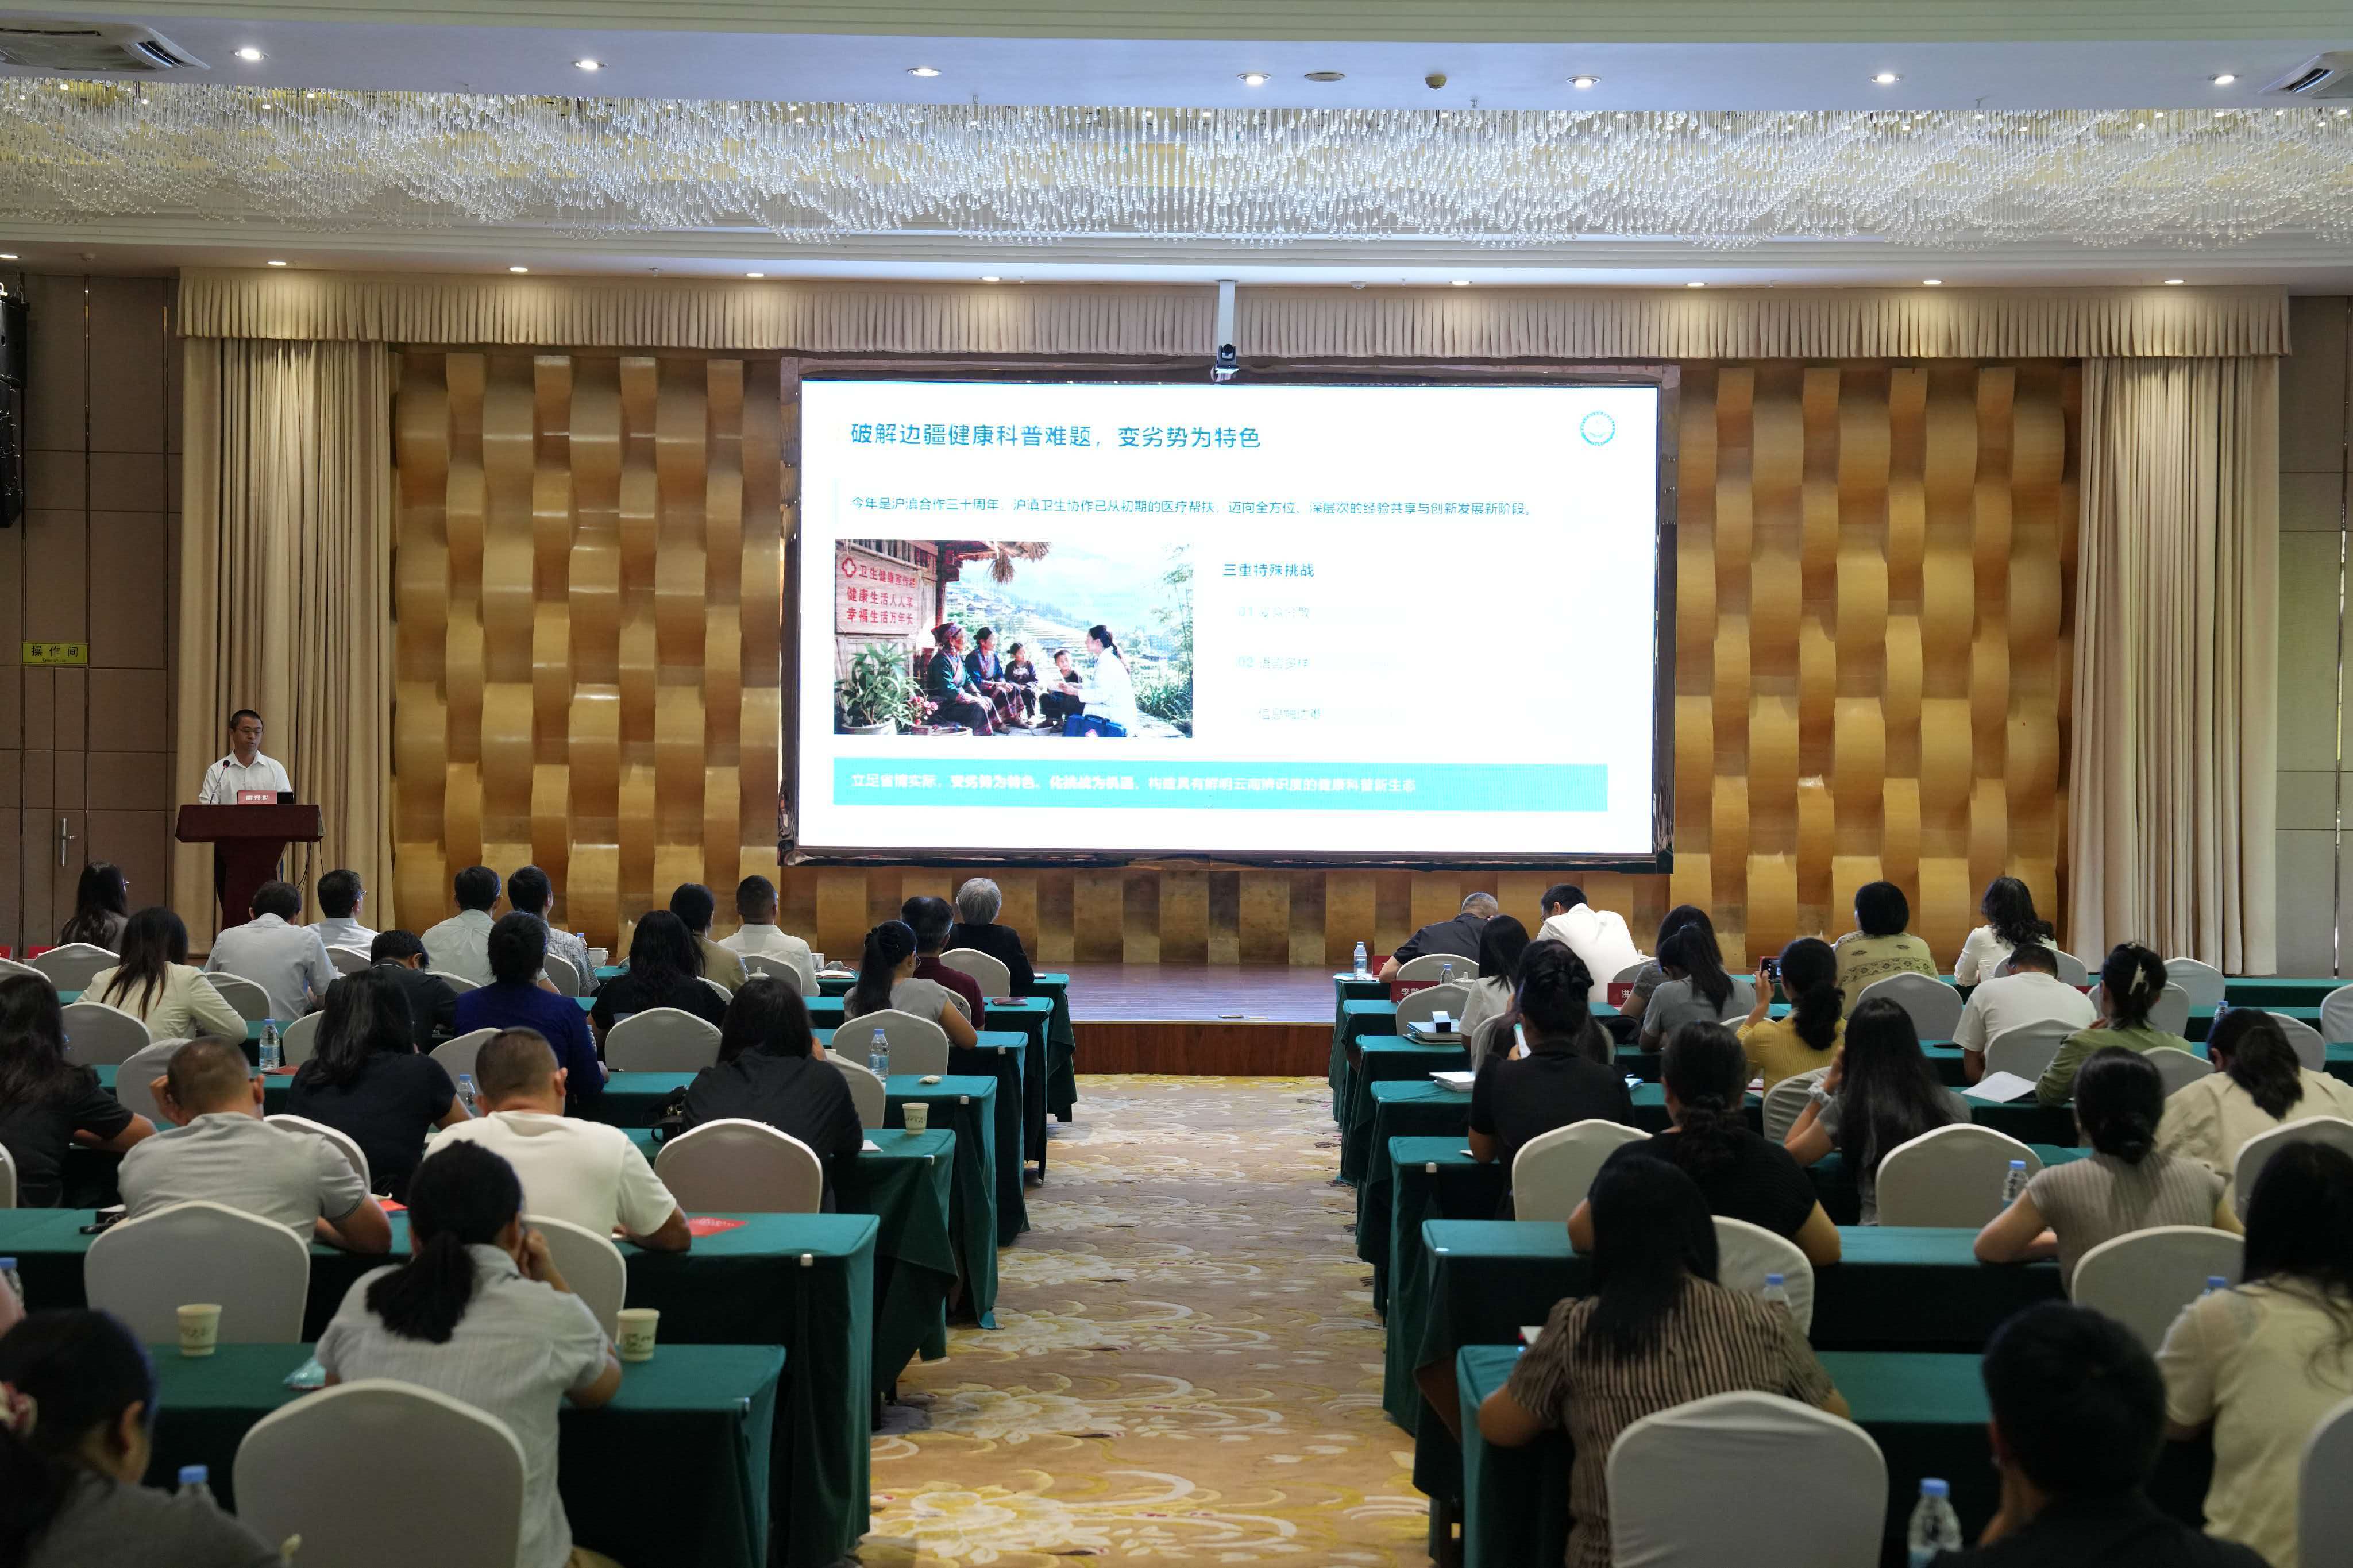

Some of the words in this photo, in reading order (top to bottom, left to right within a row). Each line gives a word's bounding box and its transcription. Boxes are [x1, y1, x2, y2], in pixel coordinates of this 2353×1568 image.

[851, 423, 1261, 449] 破解边疆健康科普难题，变劣势为特色
[1222, 563, 1314, 577] 三重特殊挑战
[847, 607, 913, 625] 幸福生活万年长
[31, 645, 78, 658] 操作间
